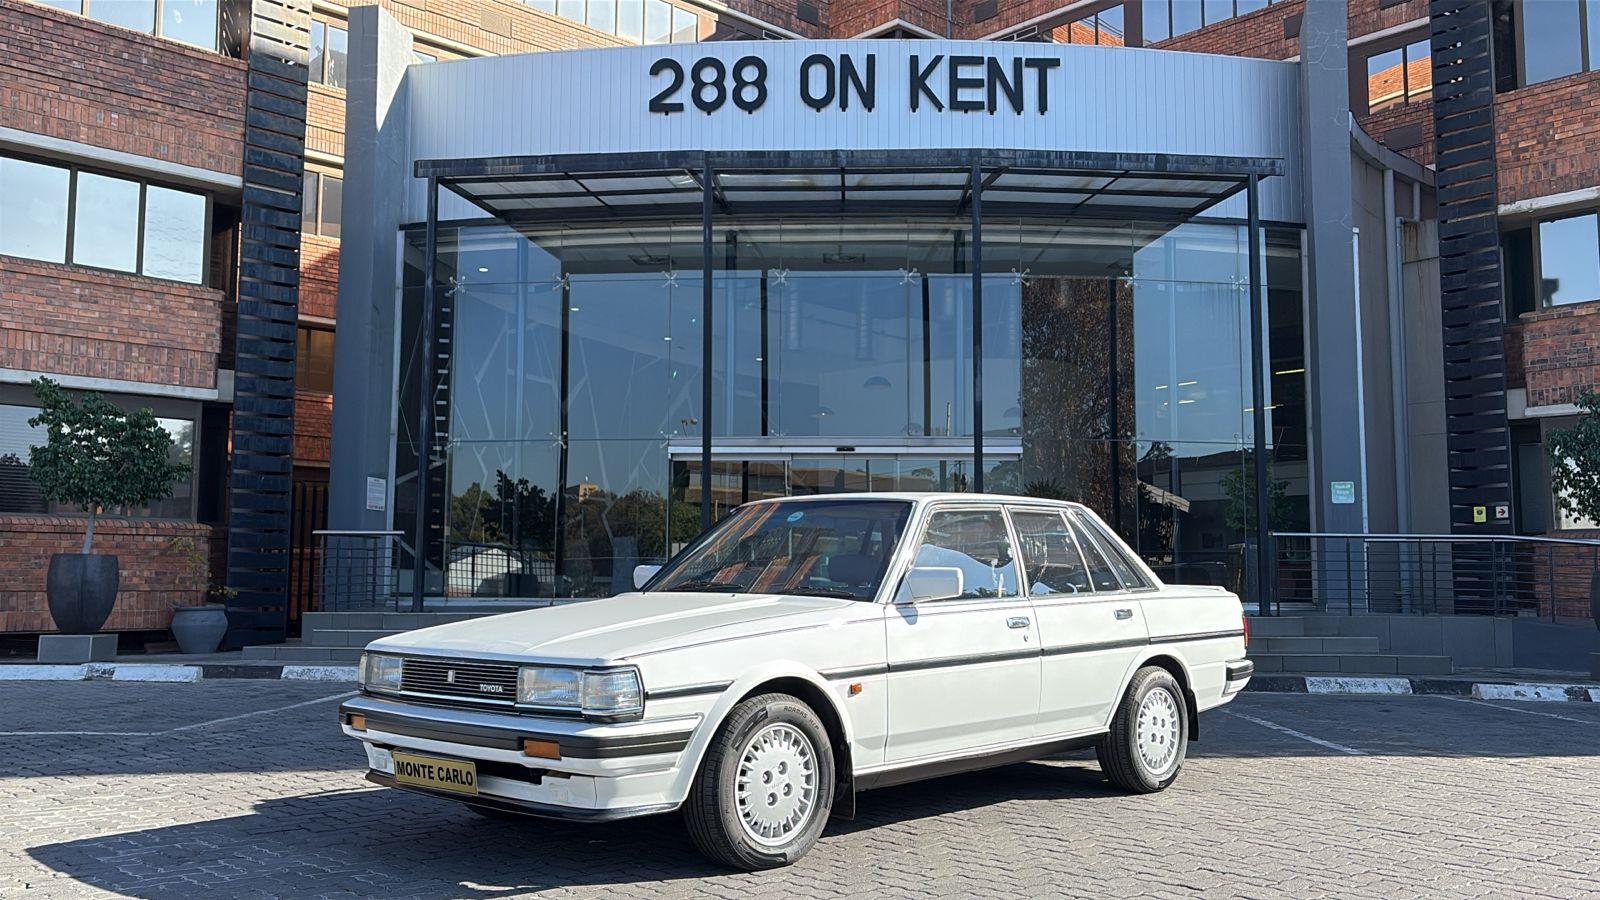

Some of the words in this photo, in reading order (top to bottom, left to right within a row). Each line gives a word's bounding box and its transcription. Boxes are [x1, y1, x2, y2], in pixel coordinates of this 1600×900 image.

[649, 56, 768, 114] 288
[800, 53, 876, 112] ON
[909, 54, 1061, 115] KENT
[480, 684, 503, 693] TOYOTA
[396, 760, 435, 780] MONTE
[437, 766, 473, 786] CARLO
